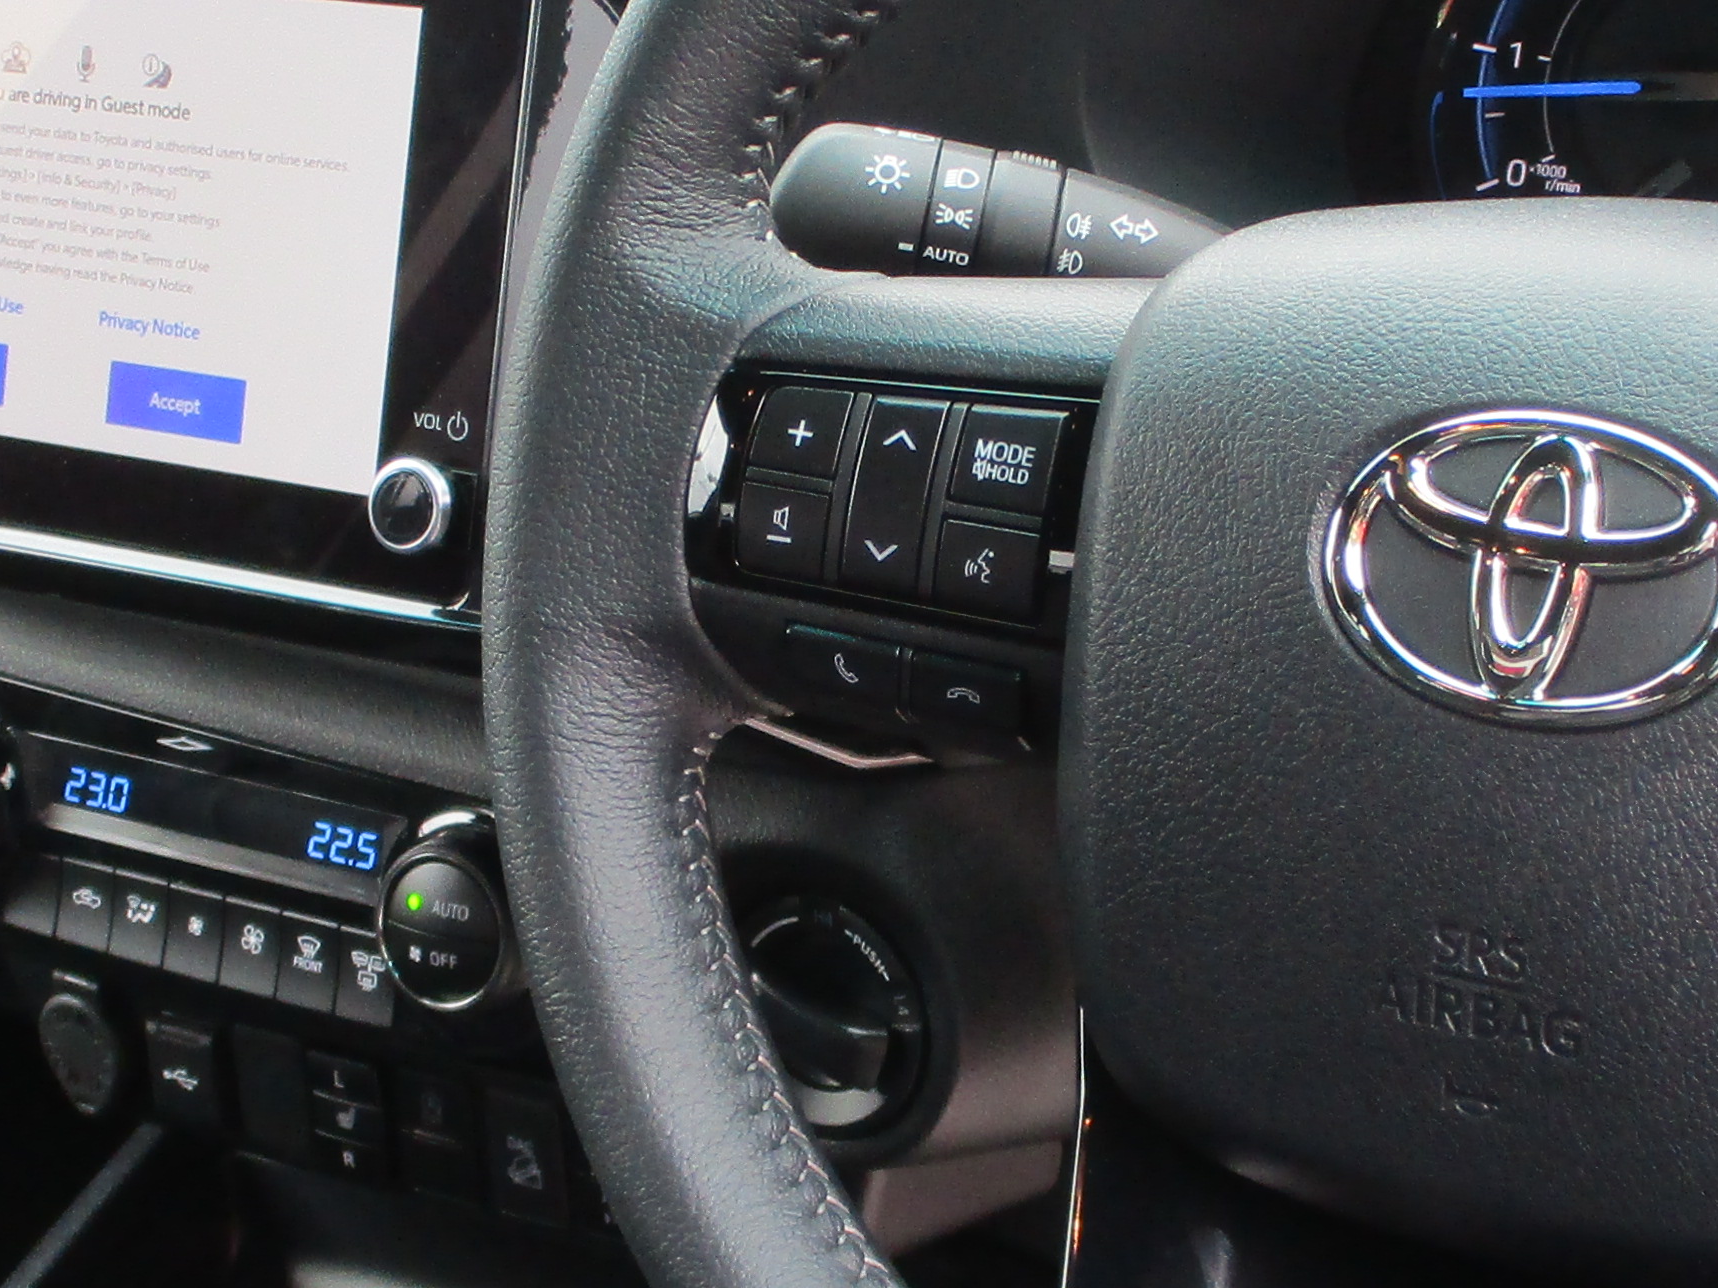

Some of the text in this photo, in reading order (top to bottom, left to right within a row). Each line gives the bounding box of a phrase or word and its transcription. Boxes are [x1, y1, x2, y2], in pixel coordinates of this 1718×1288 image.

[1508, 41, 1524, 69] 1
[8, 89, 30, 104] are
[33, 88, 82, 114] driving
[84, 94, 97, 112] in
[101, 95, 145, 117] Guest
[147, 102, 192, 121] mode
[0, 122, 26, 136] send
[27, 127, 51, 139] your
[53, 127, 78, 141] data
[80, 130, 92, 143] to
[93, 130, 129, 148] Toyota
[131, 136, 152, 150] and
[154, 139, 215, 157] authorised
[215, 147, 245, 161] users
[248, 148, 263, 162] for
[265, 152, 301, 168] online
[25, 146, 55, 161] driver
[96, 156, 112, 170] go
[113, 158, 126, 169] to
[127, 159, 166, 177] privacy
[1506, 158, 1527, 187] 0
[63, 174, 73, 186] &
[1545, 178, 1582, 194] r/min
[0, 190, 12, 202] to
[13, 192, 40, 204] even
[41, 195, 69, 209] more
[119, 206, 135, 219] go
[136, 207, 149, 219] to
[149, 210, 175, 223] your
[176, 212, 222, 230] settings
[11, 215, 45, 228] create
[46, 219, 68, 231] and
[69, 220, 88, 235] link
[89, 225, 115, 238] your
[41, 241, 62, 255] you
[62, 244, 93, 259] agree
[95, 247, 119, 261] with
[120, 250, 139, 263] the
[140, 250, 173, 269] Terms
[174, 255, 188, 269] of
[188, 258, 211, 274] Use
[922, 245, 970, 267] AUTO
[35, 263, 71, 280] having
[72, 266, 98, 282] read
[99, 270, 118, 285] the
[119, 271, 157, 292] Privacy
[98, 309, 201, 341] Privacy Notice
[149, 392, 202, 419] Accept
[413, 411, 443, 432] VOL
[973, 437, 1037, 468] MODE
[985, 462, 1030, 486] HOLD
[63, 767, 131, 814] 23.0
[306, 820, 381, 871] 22.5
[431, 899, 471, 923] AUTO
[292, 955, 324, 974] FRONT
[429, 951, 459, 970] OFF
[1432, 924, 1530, 982] SRS
[1378, 975, 1584, 1059] AIRBAG
